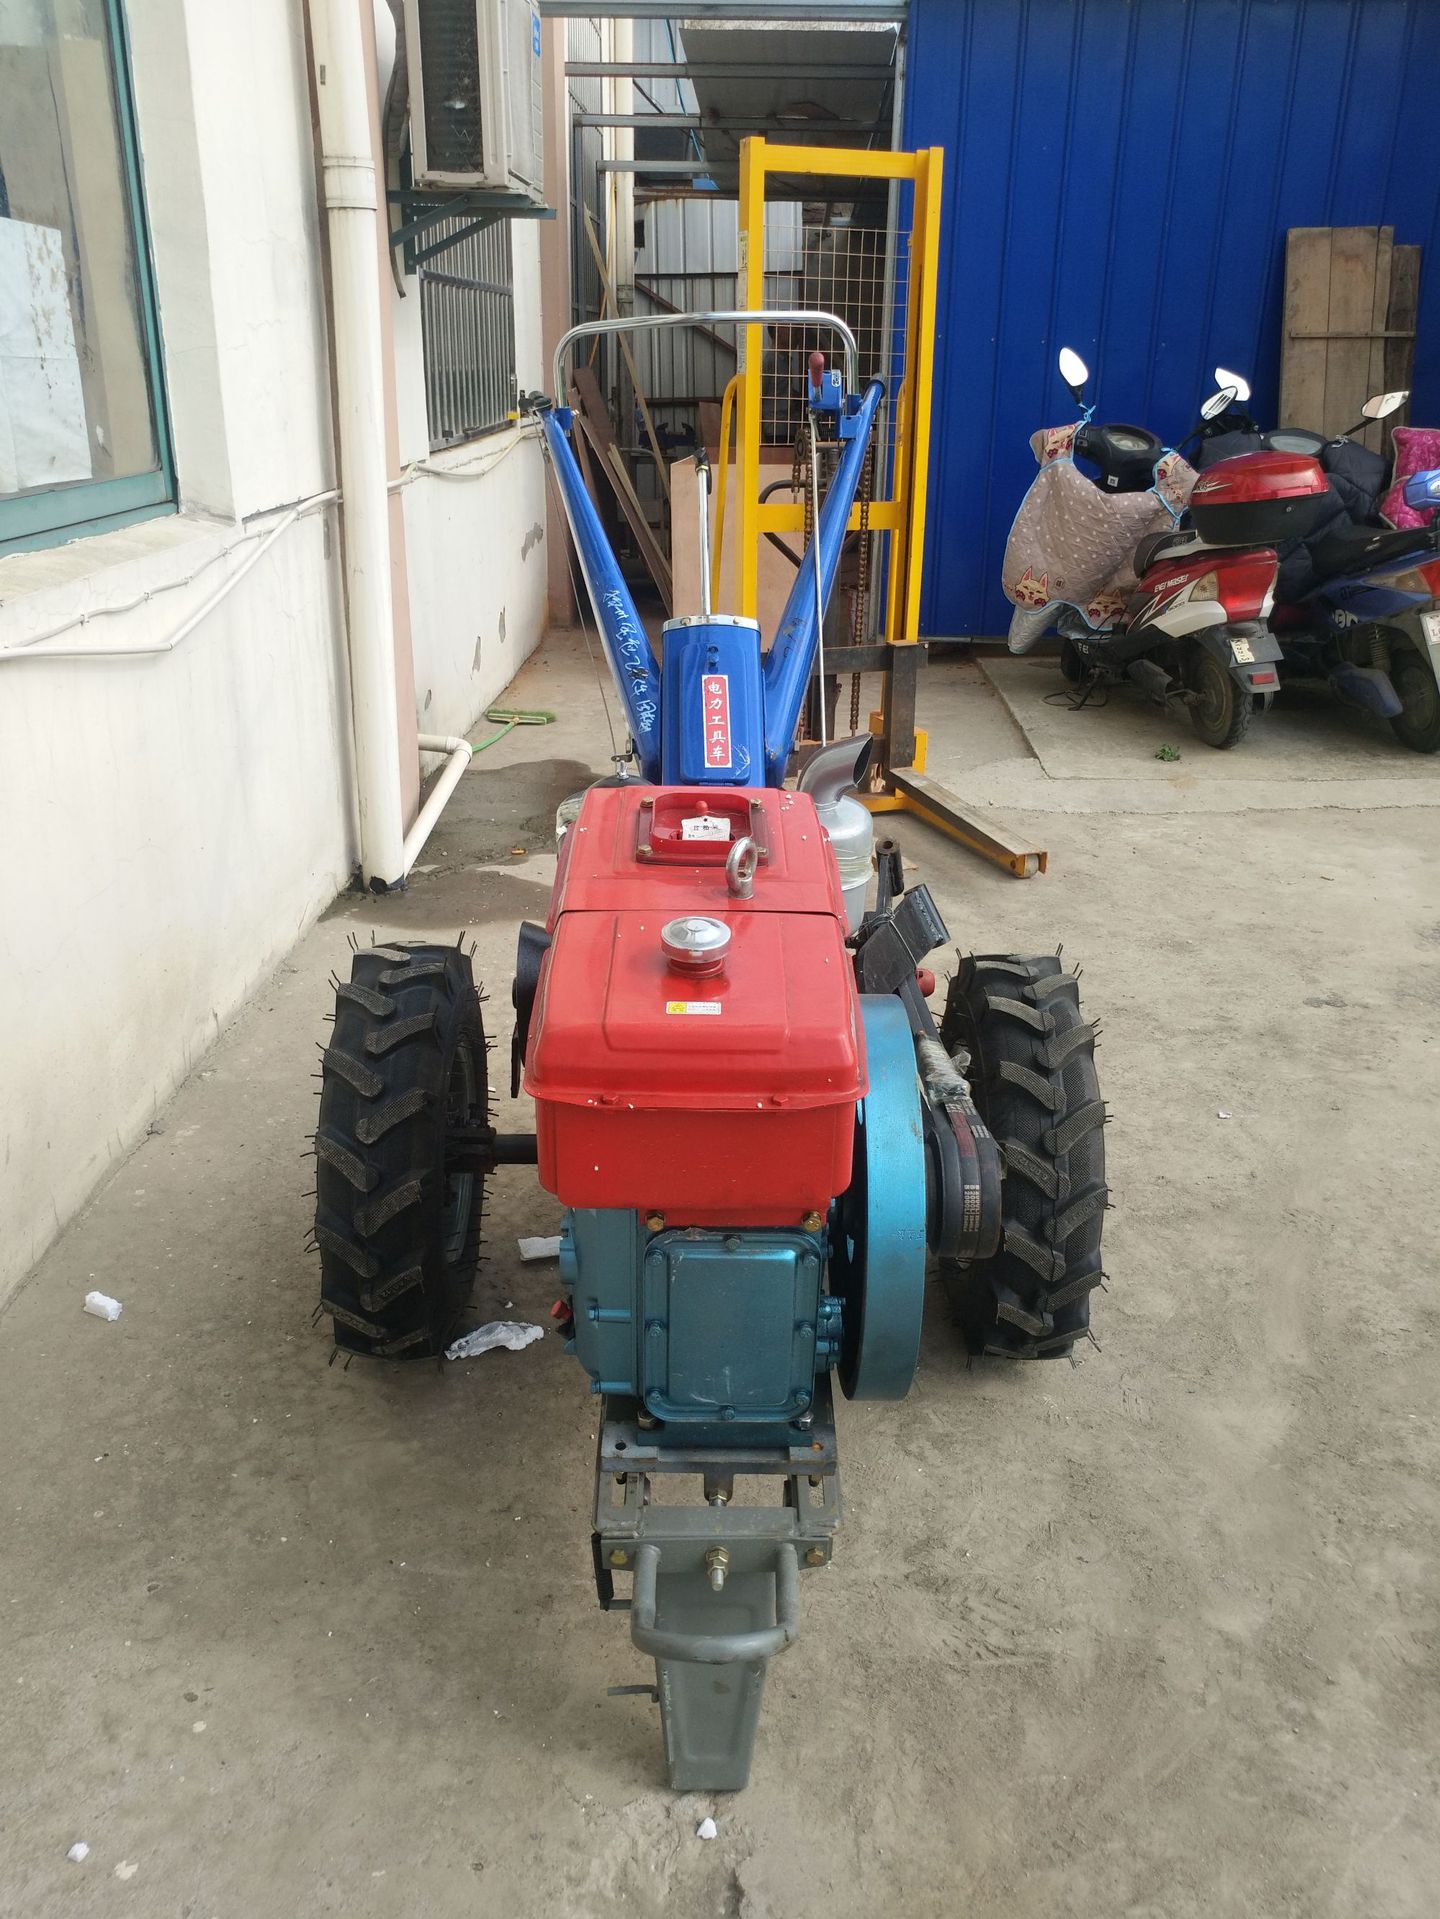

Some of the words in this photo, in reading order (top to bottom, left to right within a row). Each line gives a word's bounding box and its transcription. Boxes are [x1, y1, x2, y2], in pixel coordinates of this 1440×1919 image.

[708, 682, 726, 762] 电力工具车
